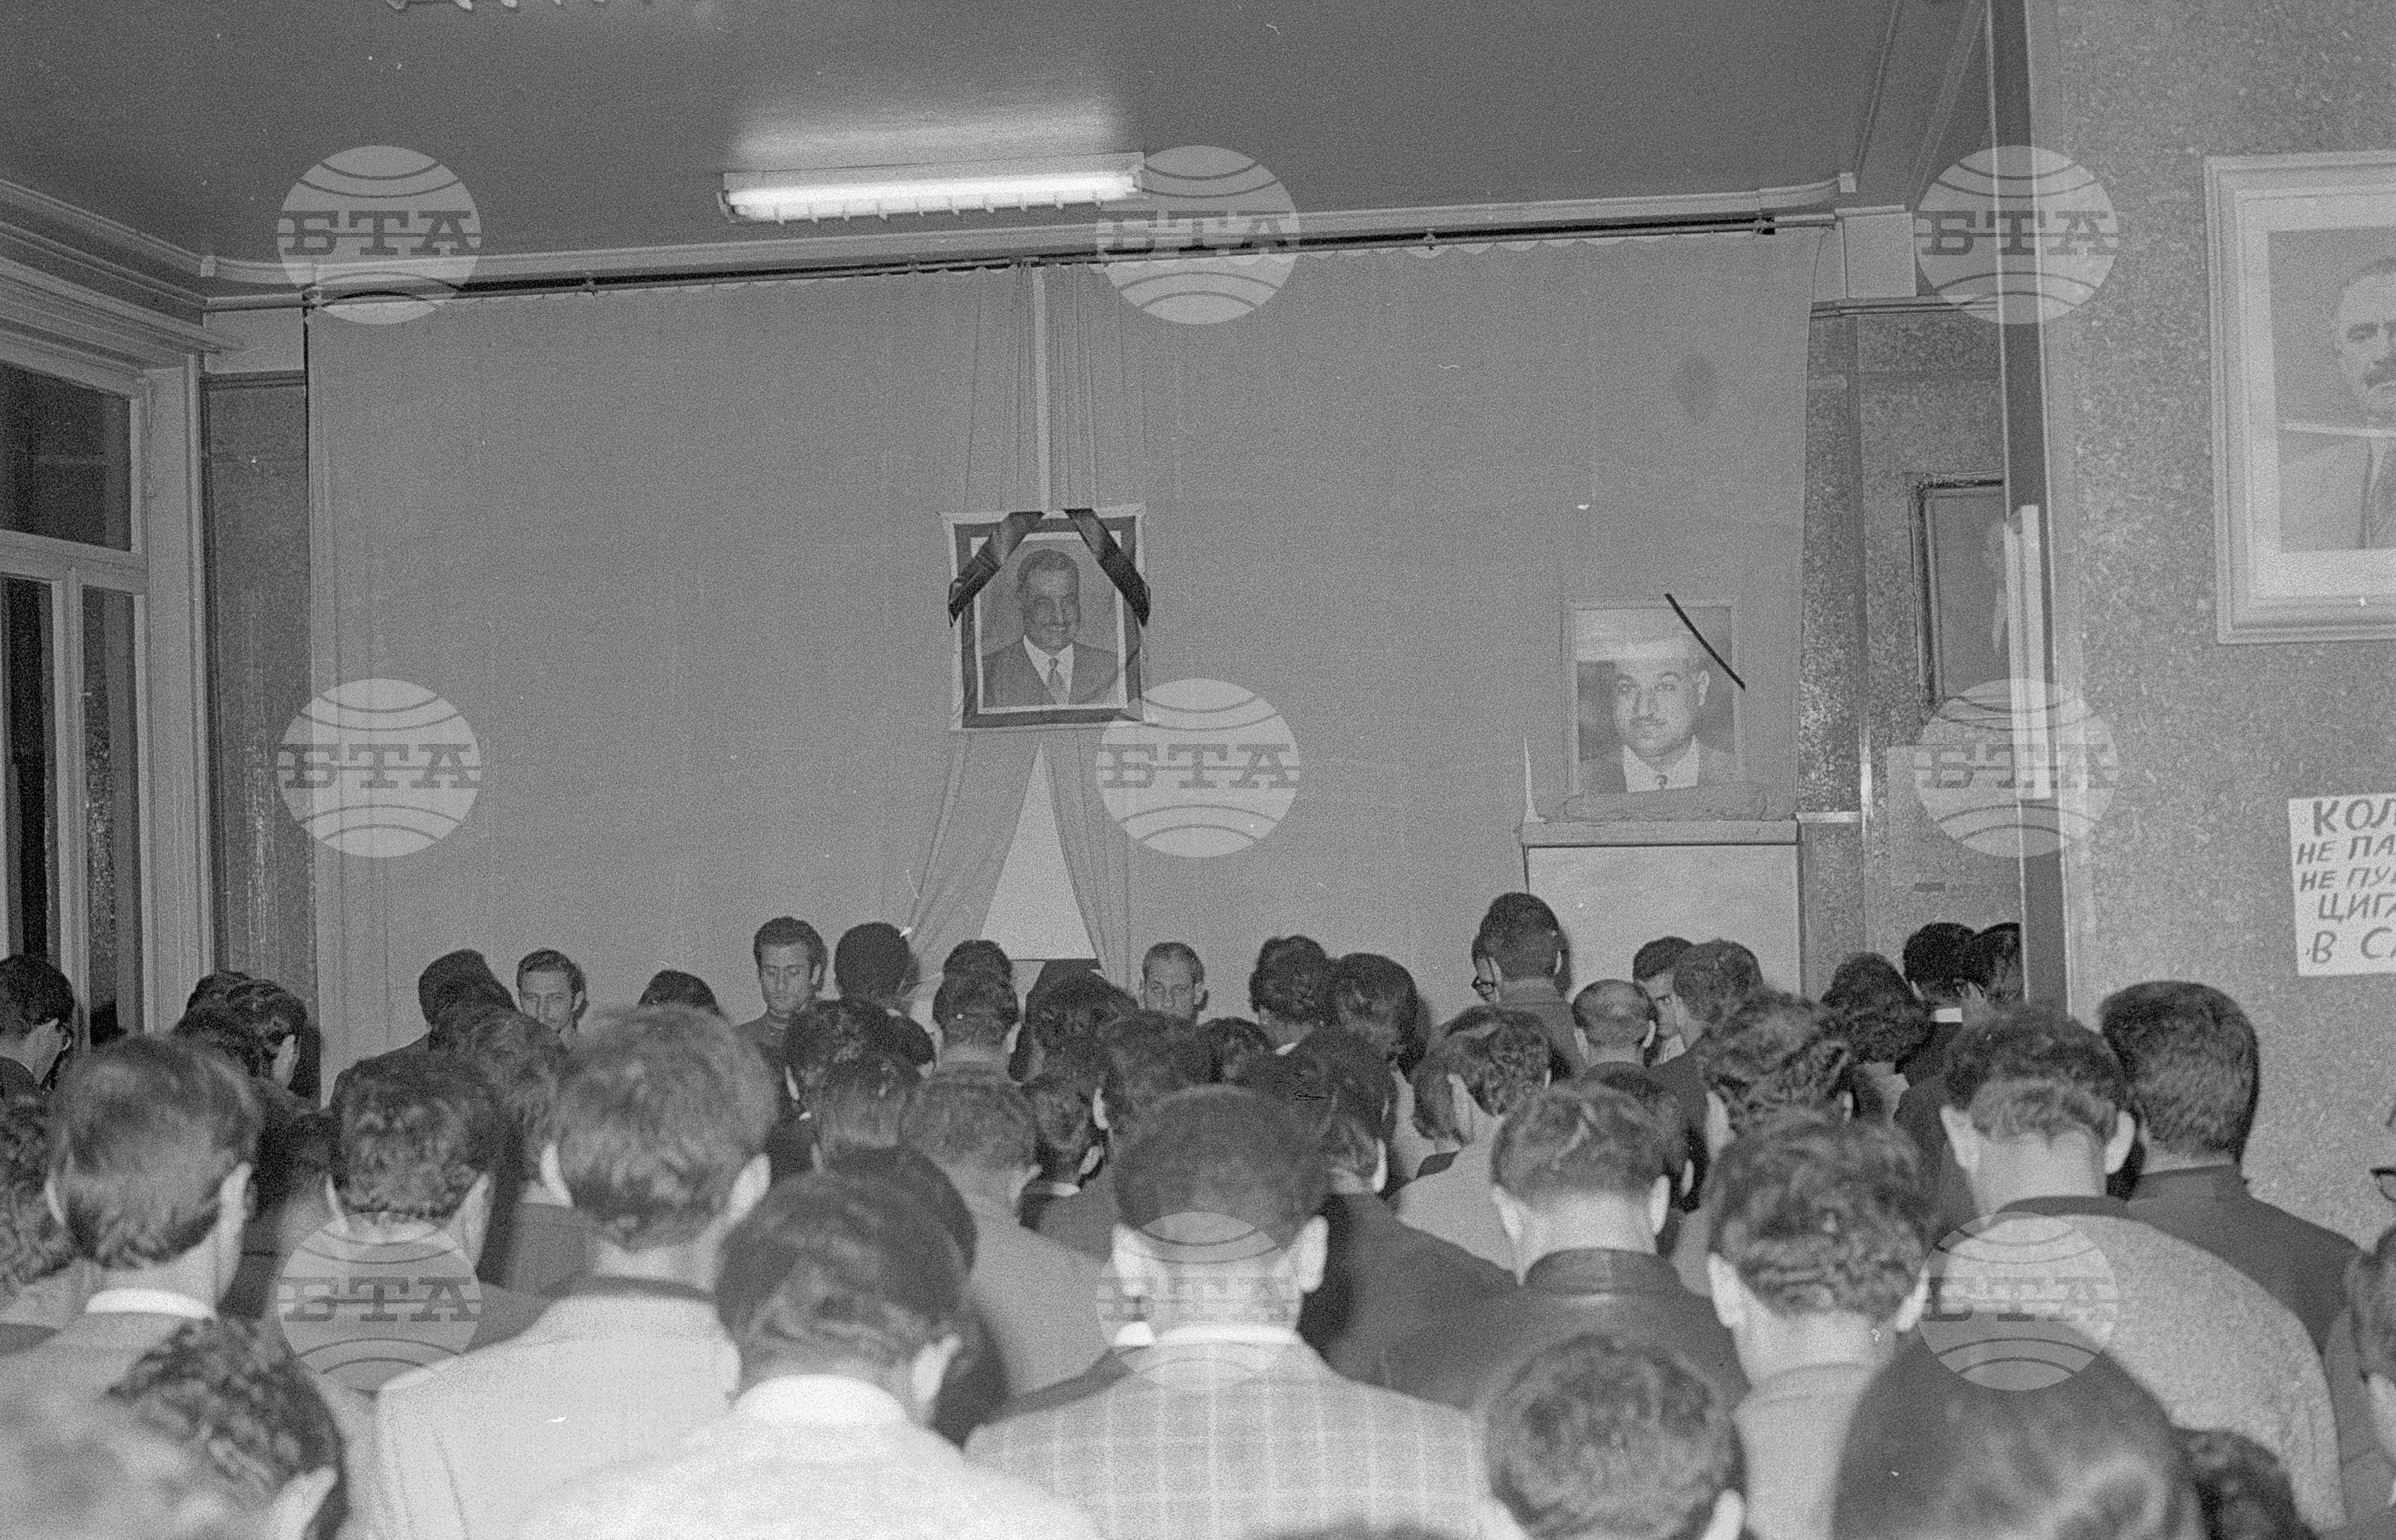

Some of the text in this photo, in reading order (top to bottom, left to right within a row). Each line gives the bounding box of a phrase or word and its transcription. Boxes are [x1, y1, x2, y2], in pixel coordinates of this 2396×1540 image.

[2297, 840, 2337, 865] НЕ
[2300, 866, 2396, 892] НЕ ПУ
[2312, 928, 2396, 963] В С
